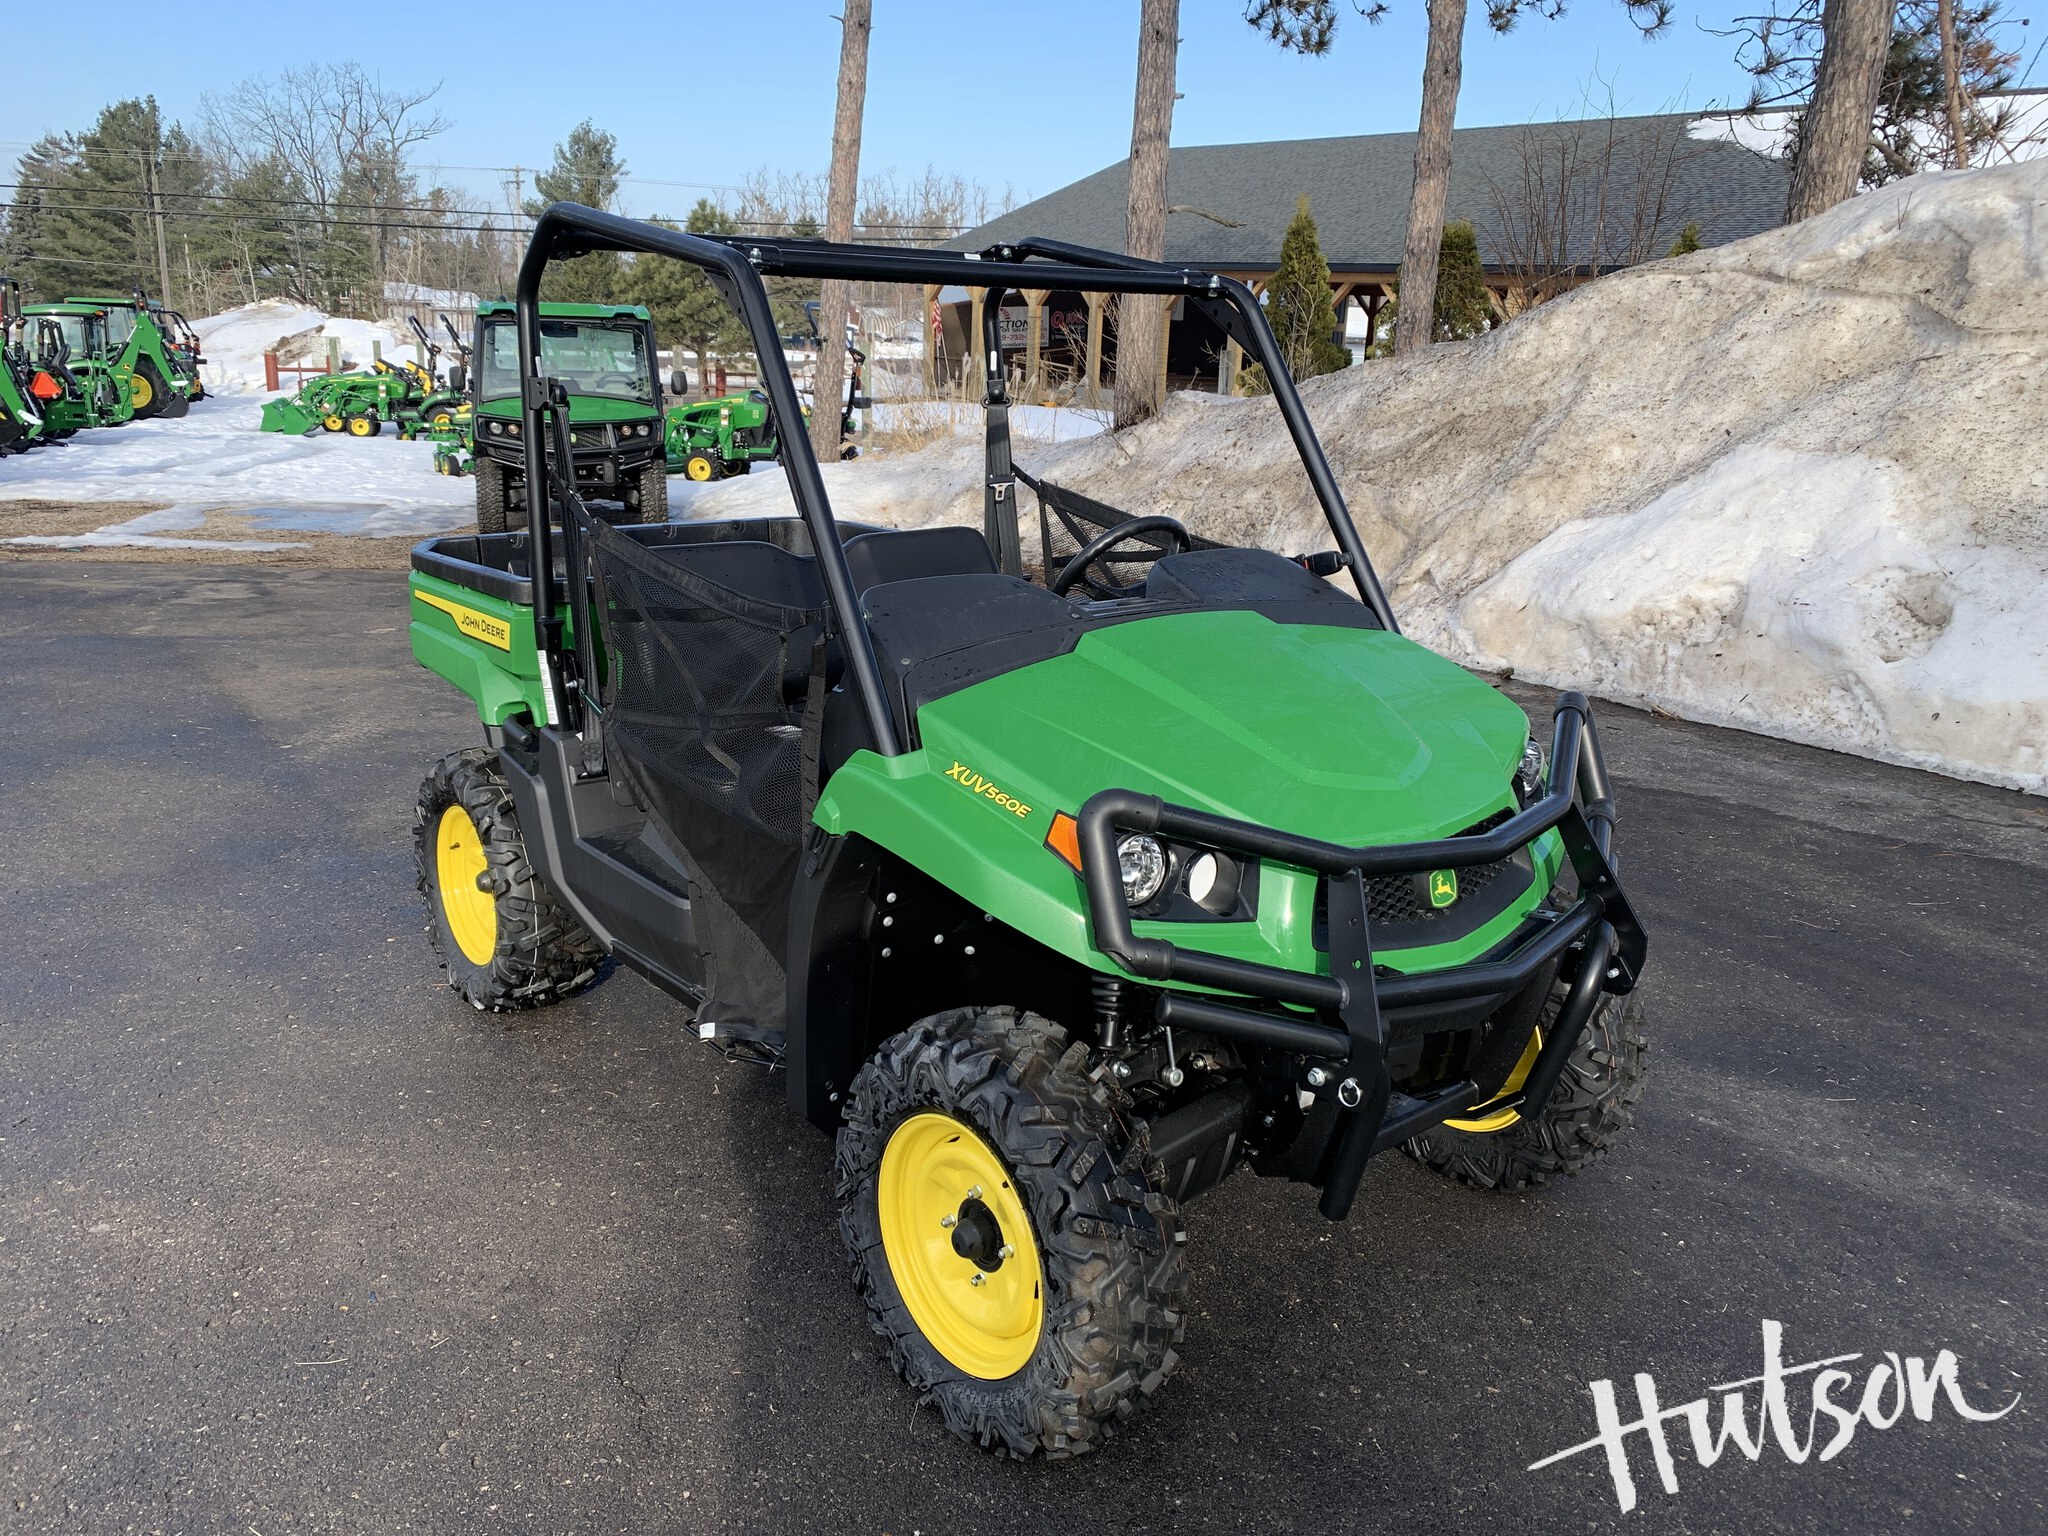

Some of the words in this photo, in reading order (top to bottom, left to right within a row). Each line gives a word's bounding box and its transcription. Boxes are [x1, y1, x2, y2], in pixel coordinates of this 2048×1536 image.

[999, 320, 1028, 328] CTION
[461, 612, 480, 630] JOHN
[481, 619, 506, 640] DEERE
[943, 760, 1033, 819] XUV560E
